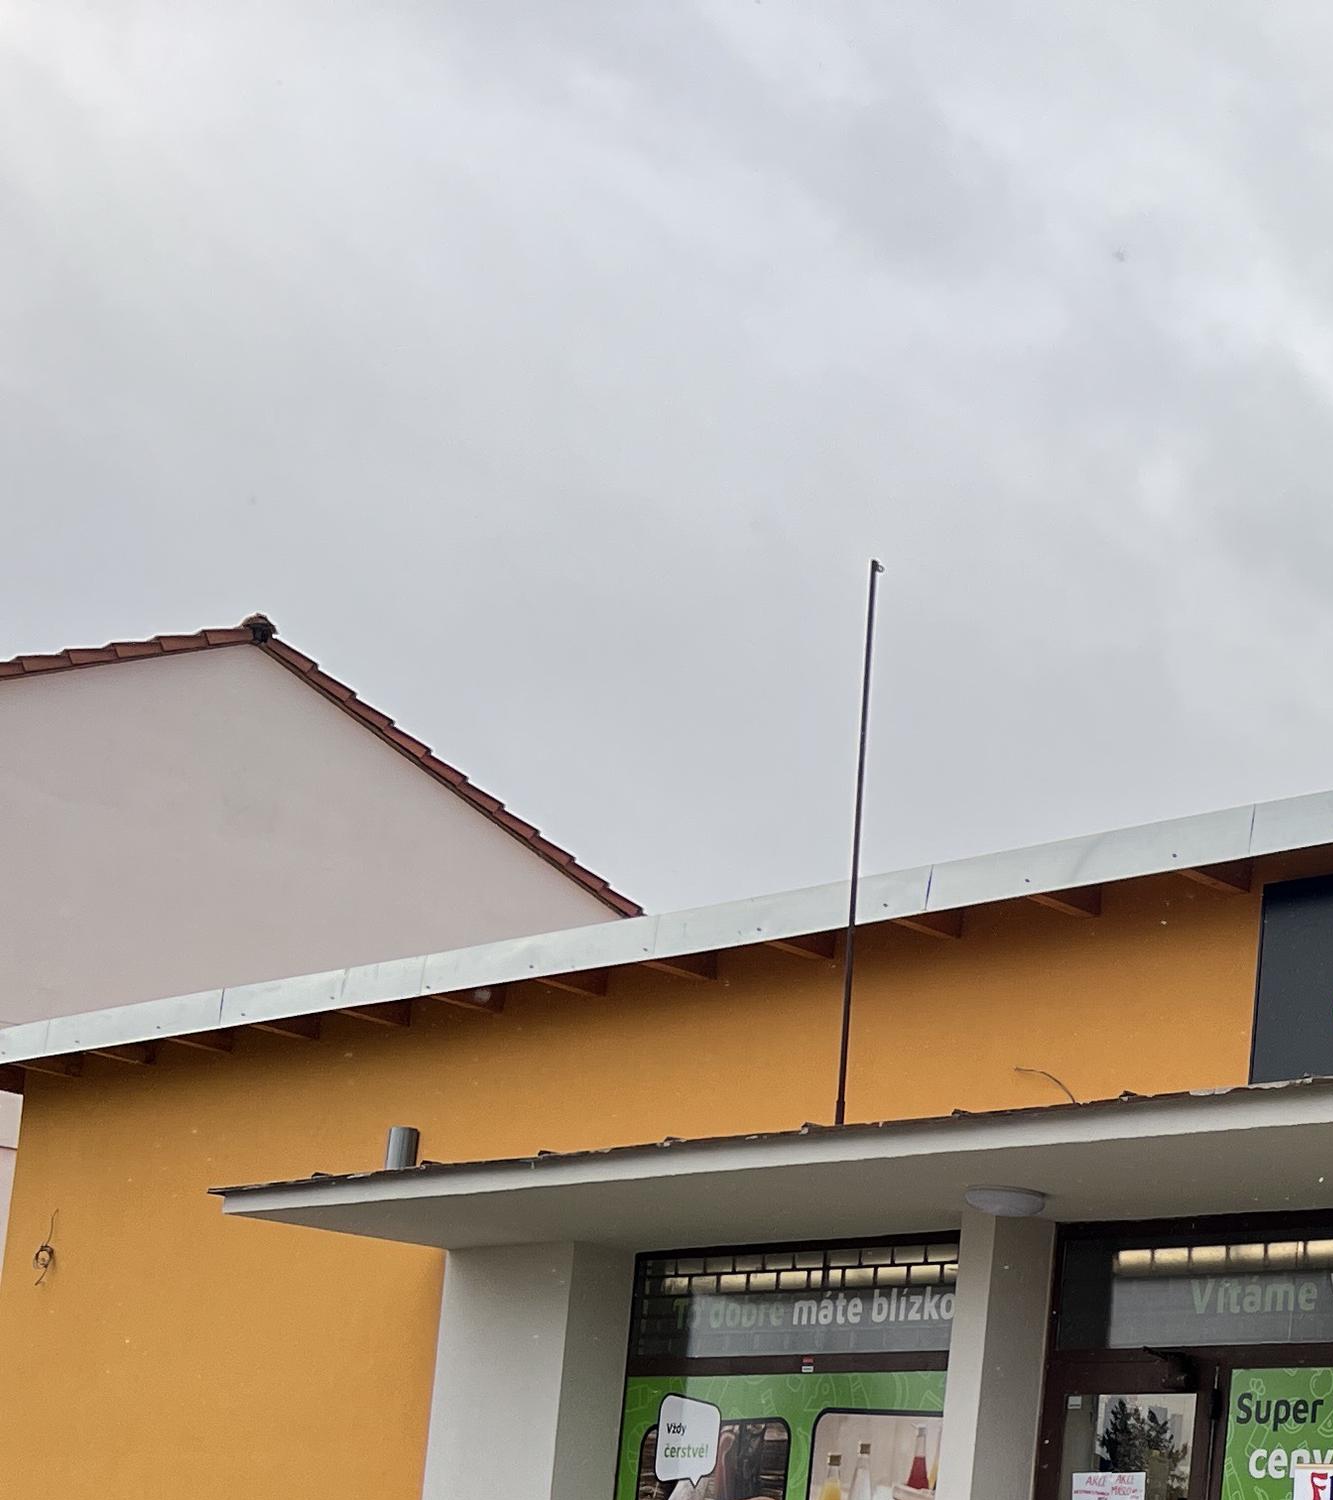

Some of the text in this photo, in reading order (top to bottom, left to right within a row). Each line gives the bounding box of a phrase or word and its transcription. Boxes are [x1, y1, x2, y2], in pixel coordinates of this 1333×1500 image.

[792, 1289, 864, 1325] máte
[871, 1285, 956, 1324] blízko
[1190, 1274, 1318, 1314] Vítáme
[1236, 1391, 1324, 1432] Super
